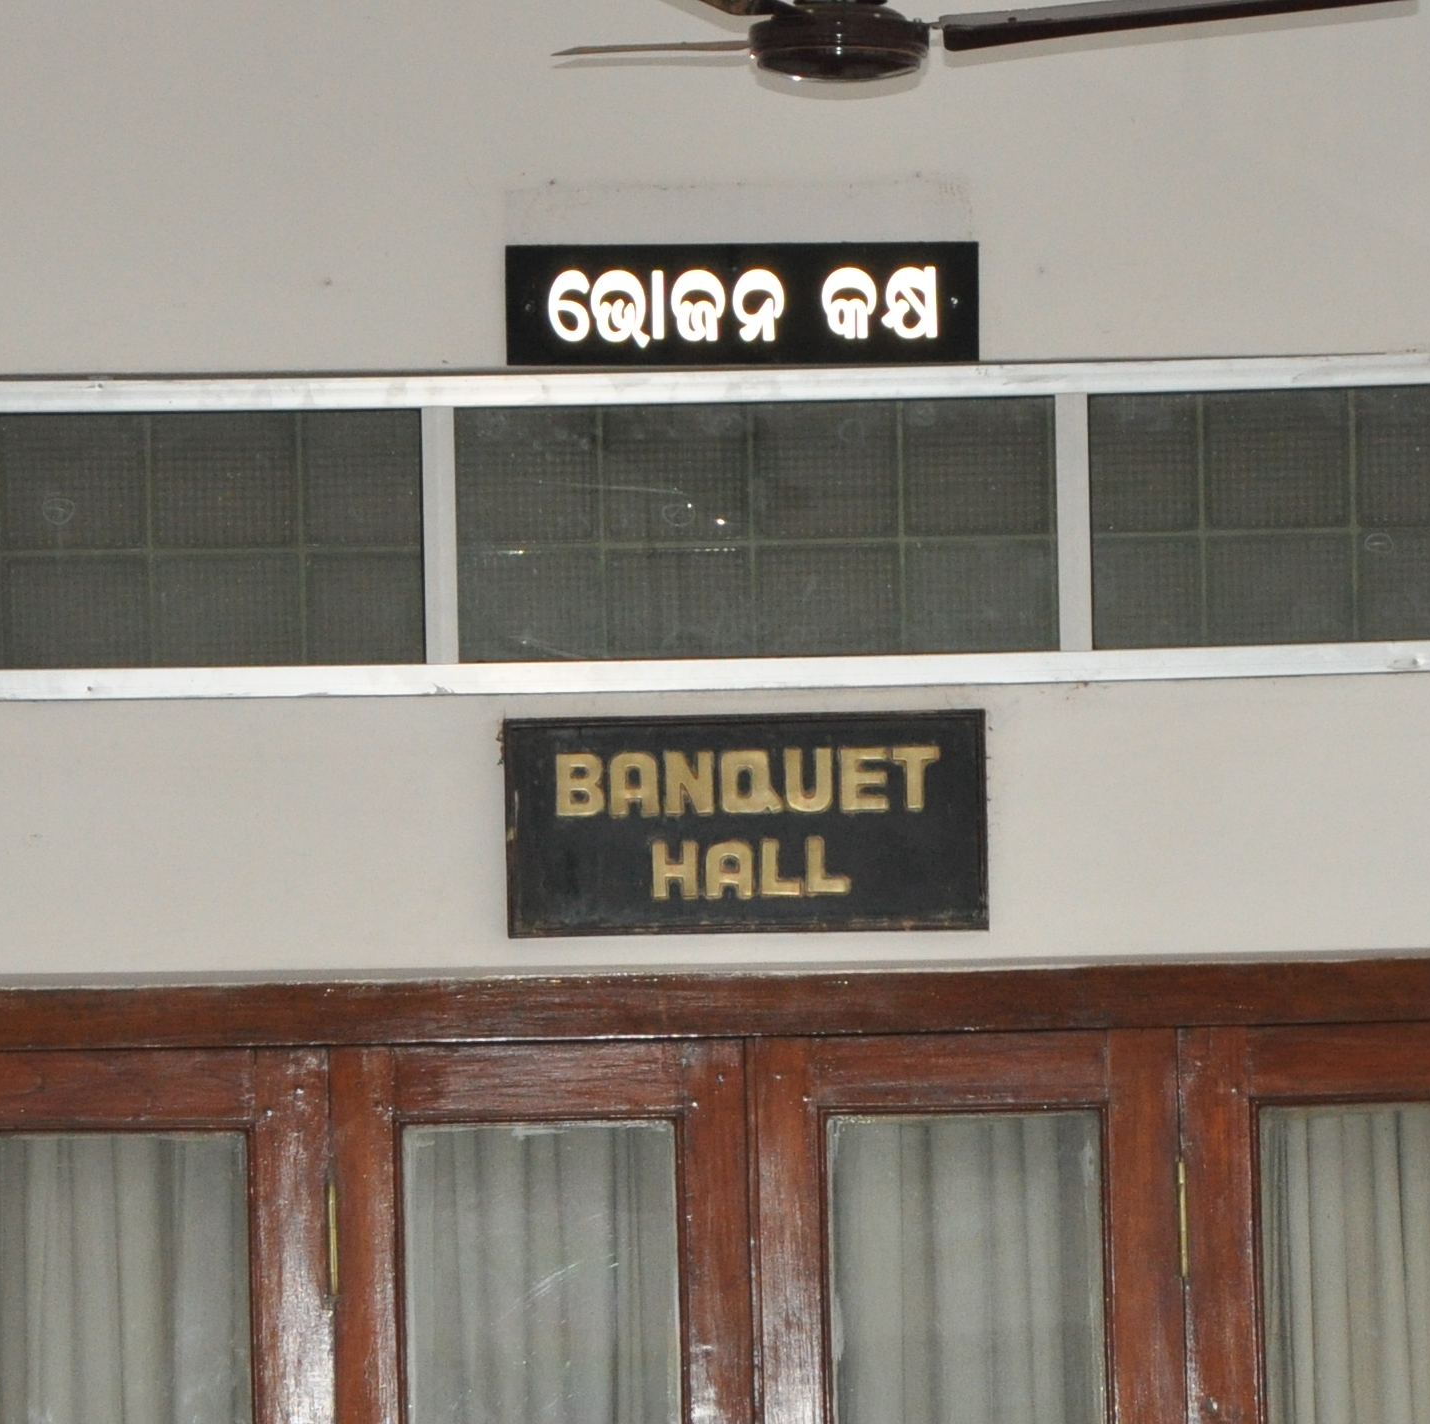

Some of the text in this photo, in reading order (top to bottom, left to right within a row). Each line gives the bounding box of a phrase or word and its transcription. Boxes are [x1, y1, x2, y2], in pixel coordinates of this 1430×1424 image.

[548, 265, 938, 348] ଭୋଜନ କକ୍ଷ
[554, 746, 940, 817] BANQUET
[652, 836, 850, 900] HALL
